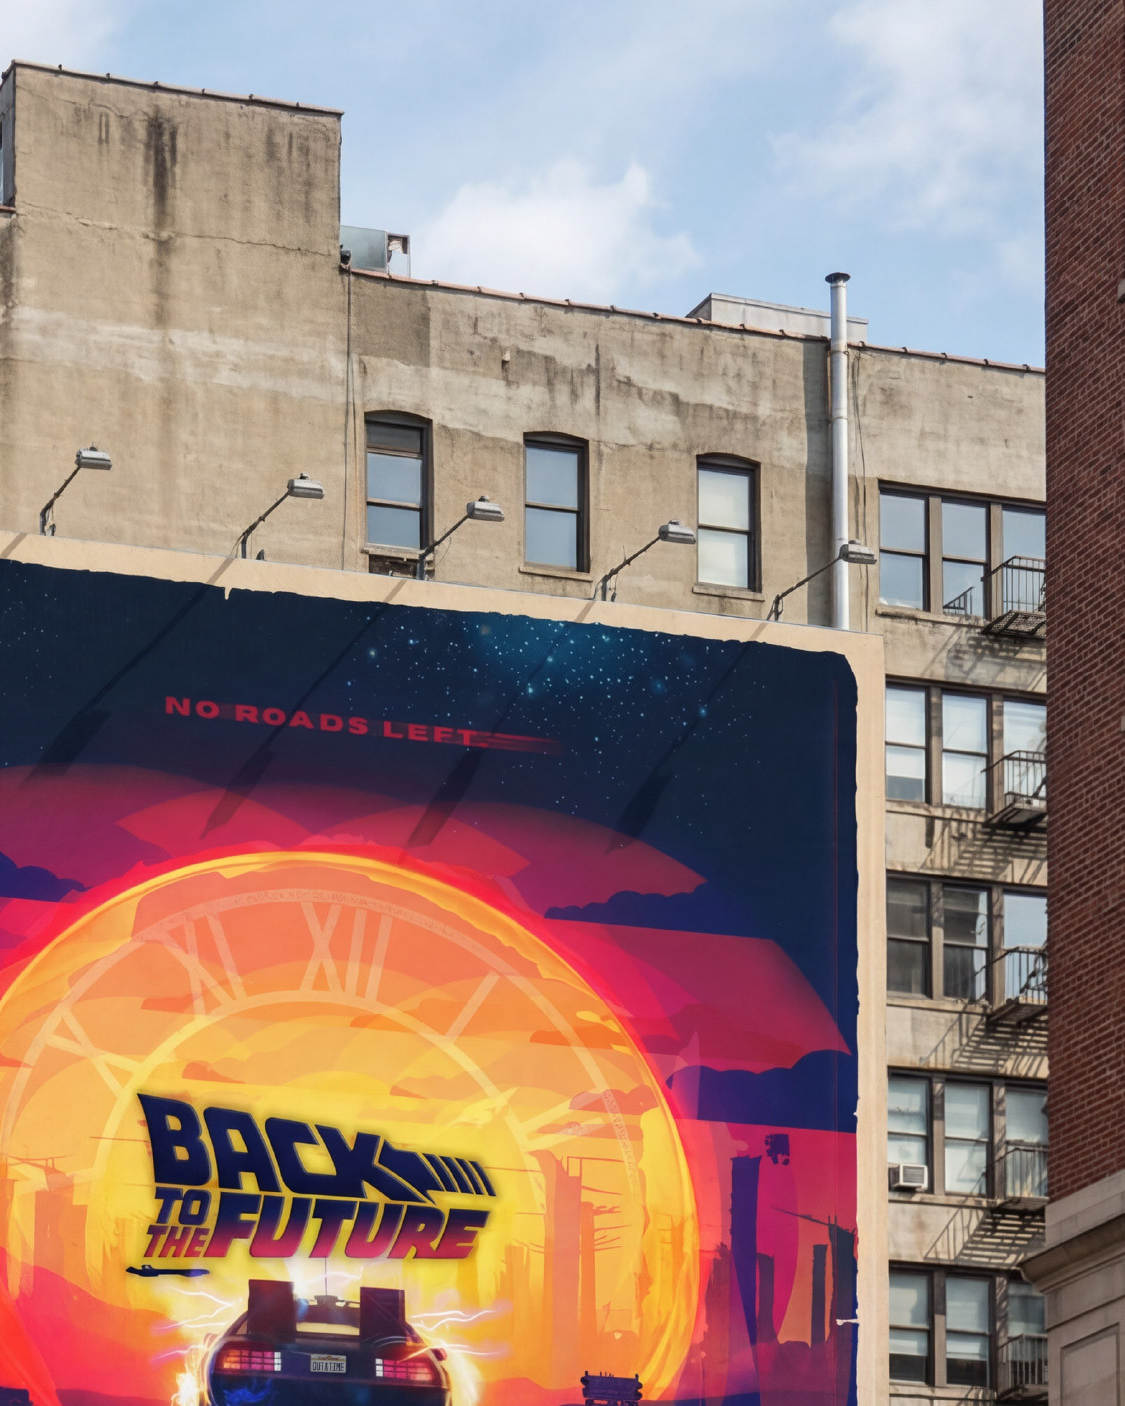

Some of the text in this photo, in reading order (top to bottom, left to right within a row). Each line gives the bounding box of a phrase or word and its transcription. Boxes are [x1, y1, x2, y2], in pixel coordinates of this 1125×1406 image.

[165, 696, 221, 719] NO
[235, 704, 369, 735] ROADS
[137, 1092, 497, 1205] BACK
[143, 1191, 490, 1260] THE FUTURE
[155, 1187, 212, 1226] TO
[312, 1361, 345, 1372] OUTATIME
